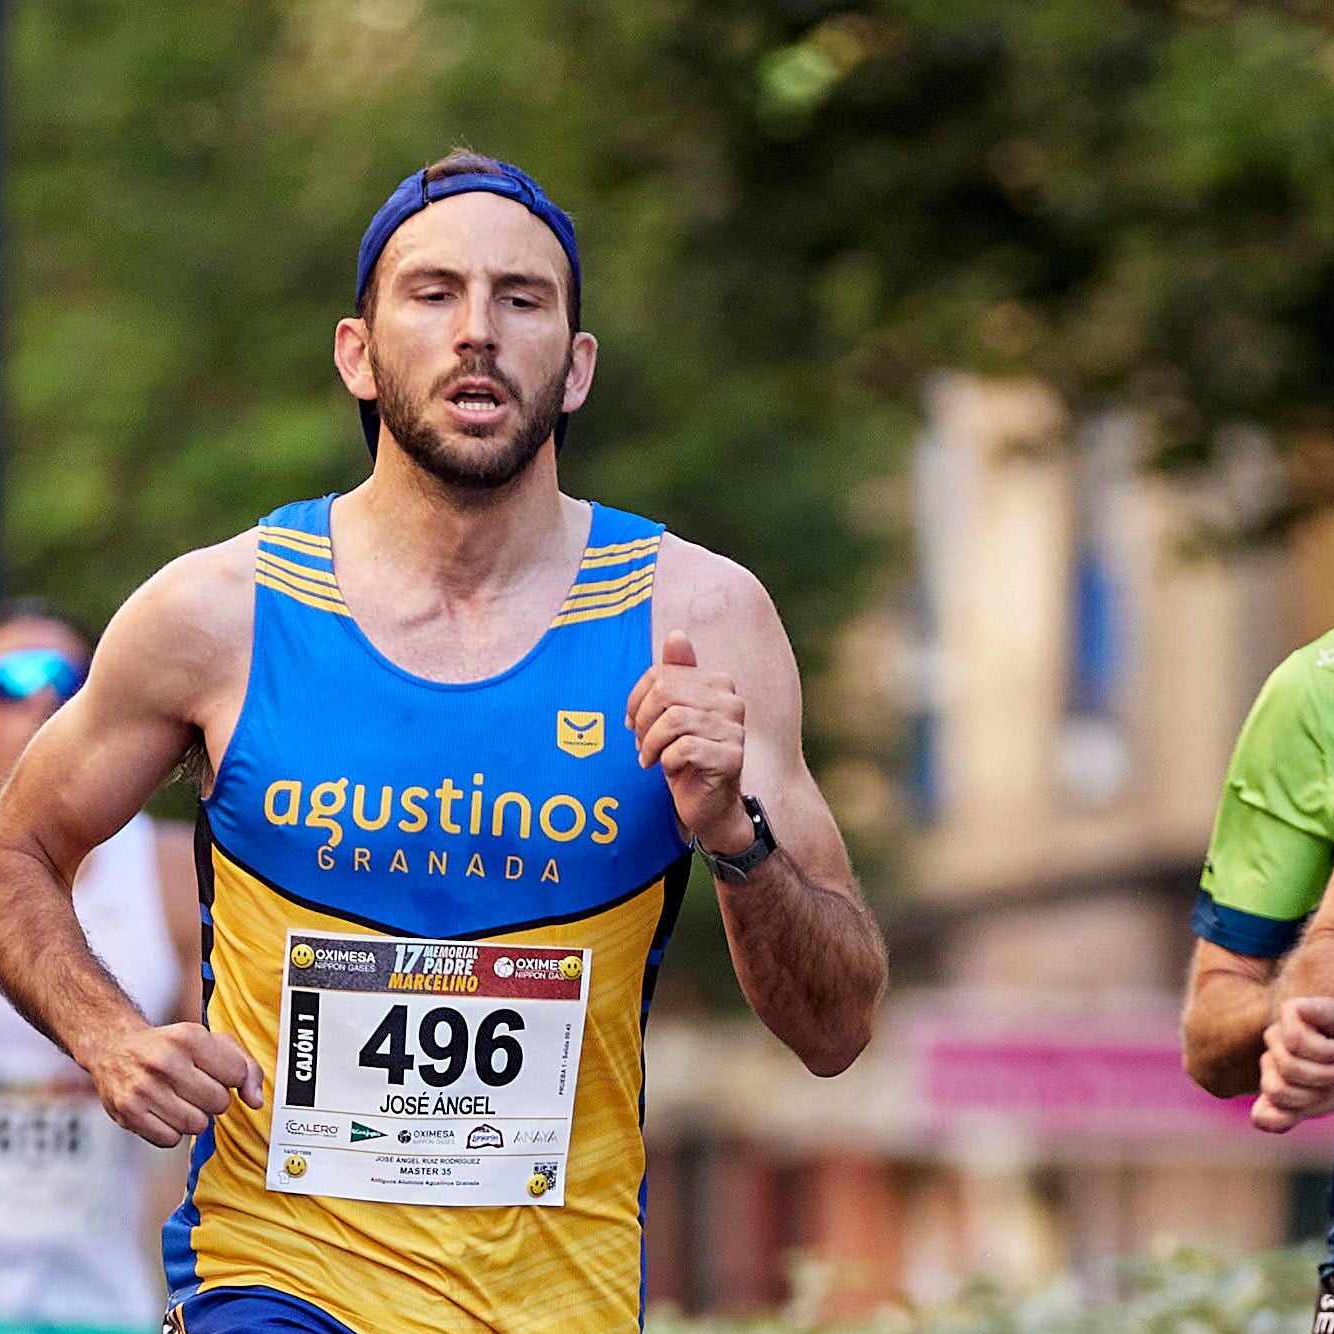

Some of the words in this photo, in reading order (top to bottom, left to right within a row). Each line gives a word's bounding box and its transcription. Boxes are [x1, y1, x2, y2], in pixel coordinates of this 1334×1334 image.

[264, 773, 619, 846] agustinos
[317, 845, 561, 883] GRANADA
[315, 949, 376, 963] OXIMESA
[395, 944, 425, 973] 17
[423, 945, 478, 959] MEMORIAL
[314, 962, 346, 972] NIPPON
[348, 964, 375, 973] GASES
[423, 957, 473, 976] PADRE
[515, 958, 565, 971] OXIMES
[388, 972, 478, 992] MARCELINO
[515, 971, 546, 980] NIPPON
[298, 1013, 315, 1022] 1
[358, 1004, 526, 1088] 496
[293, 1028, 315, 1082] CAJÓN
[379, 1092, 429, 1116] JOSÉ
[432, 1092, 495, 1116] ÁNGEL
[289, 1122, 338, 1134] CALERO
[413, 1130, 455, 1138] OXIMESA
[513, 1131, 558, 1143] ANAYA
[399, 1166, 439, 1176] MASTER
[441, 1168, 452, 1176] 35
